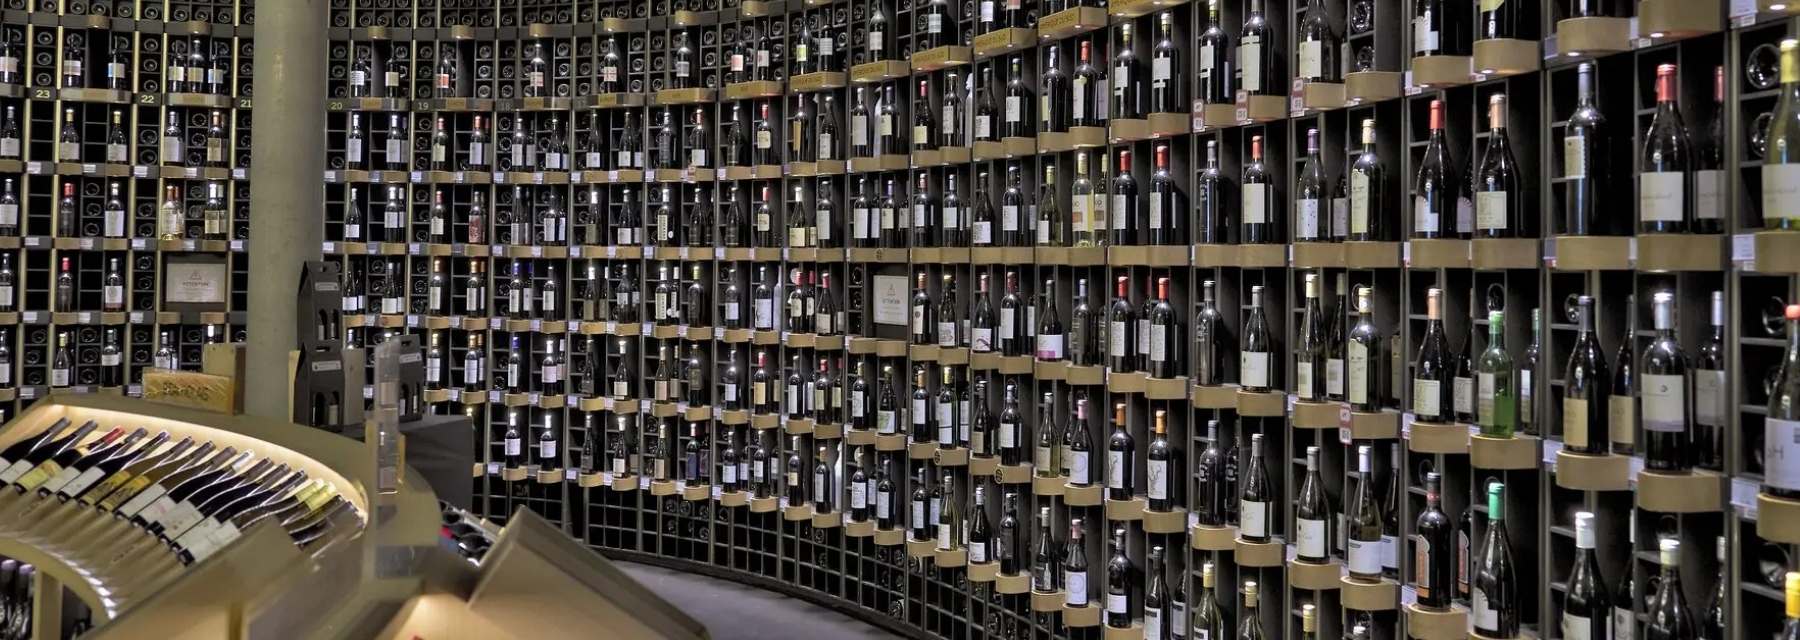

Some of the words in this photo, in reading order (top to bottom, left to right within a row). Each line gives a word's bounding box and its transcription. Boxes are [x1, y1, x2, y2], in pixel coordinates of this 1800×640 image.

[36, 89, 50, 99] 23
[141, 94, 154, 104] 22
[240, 98, 251, 108] 21
[330, 102, 343, 110] 20
[418, 102, 429, 110] 19
